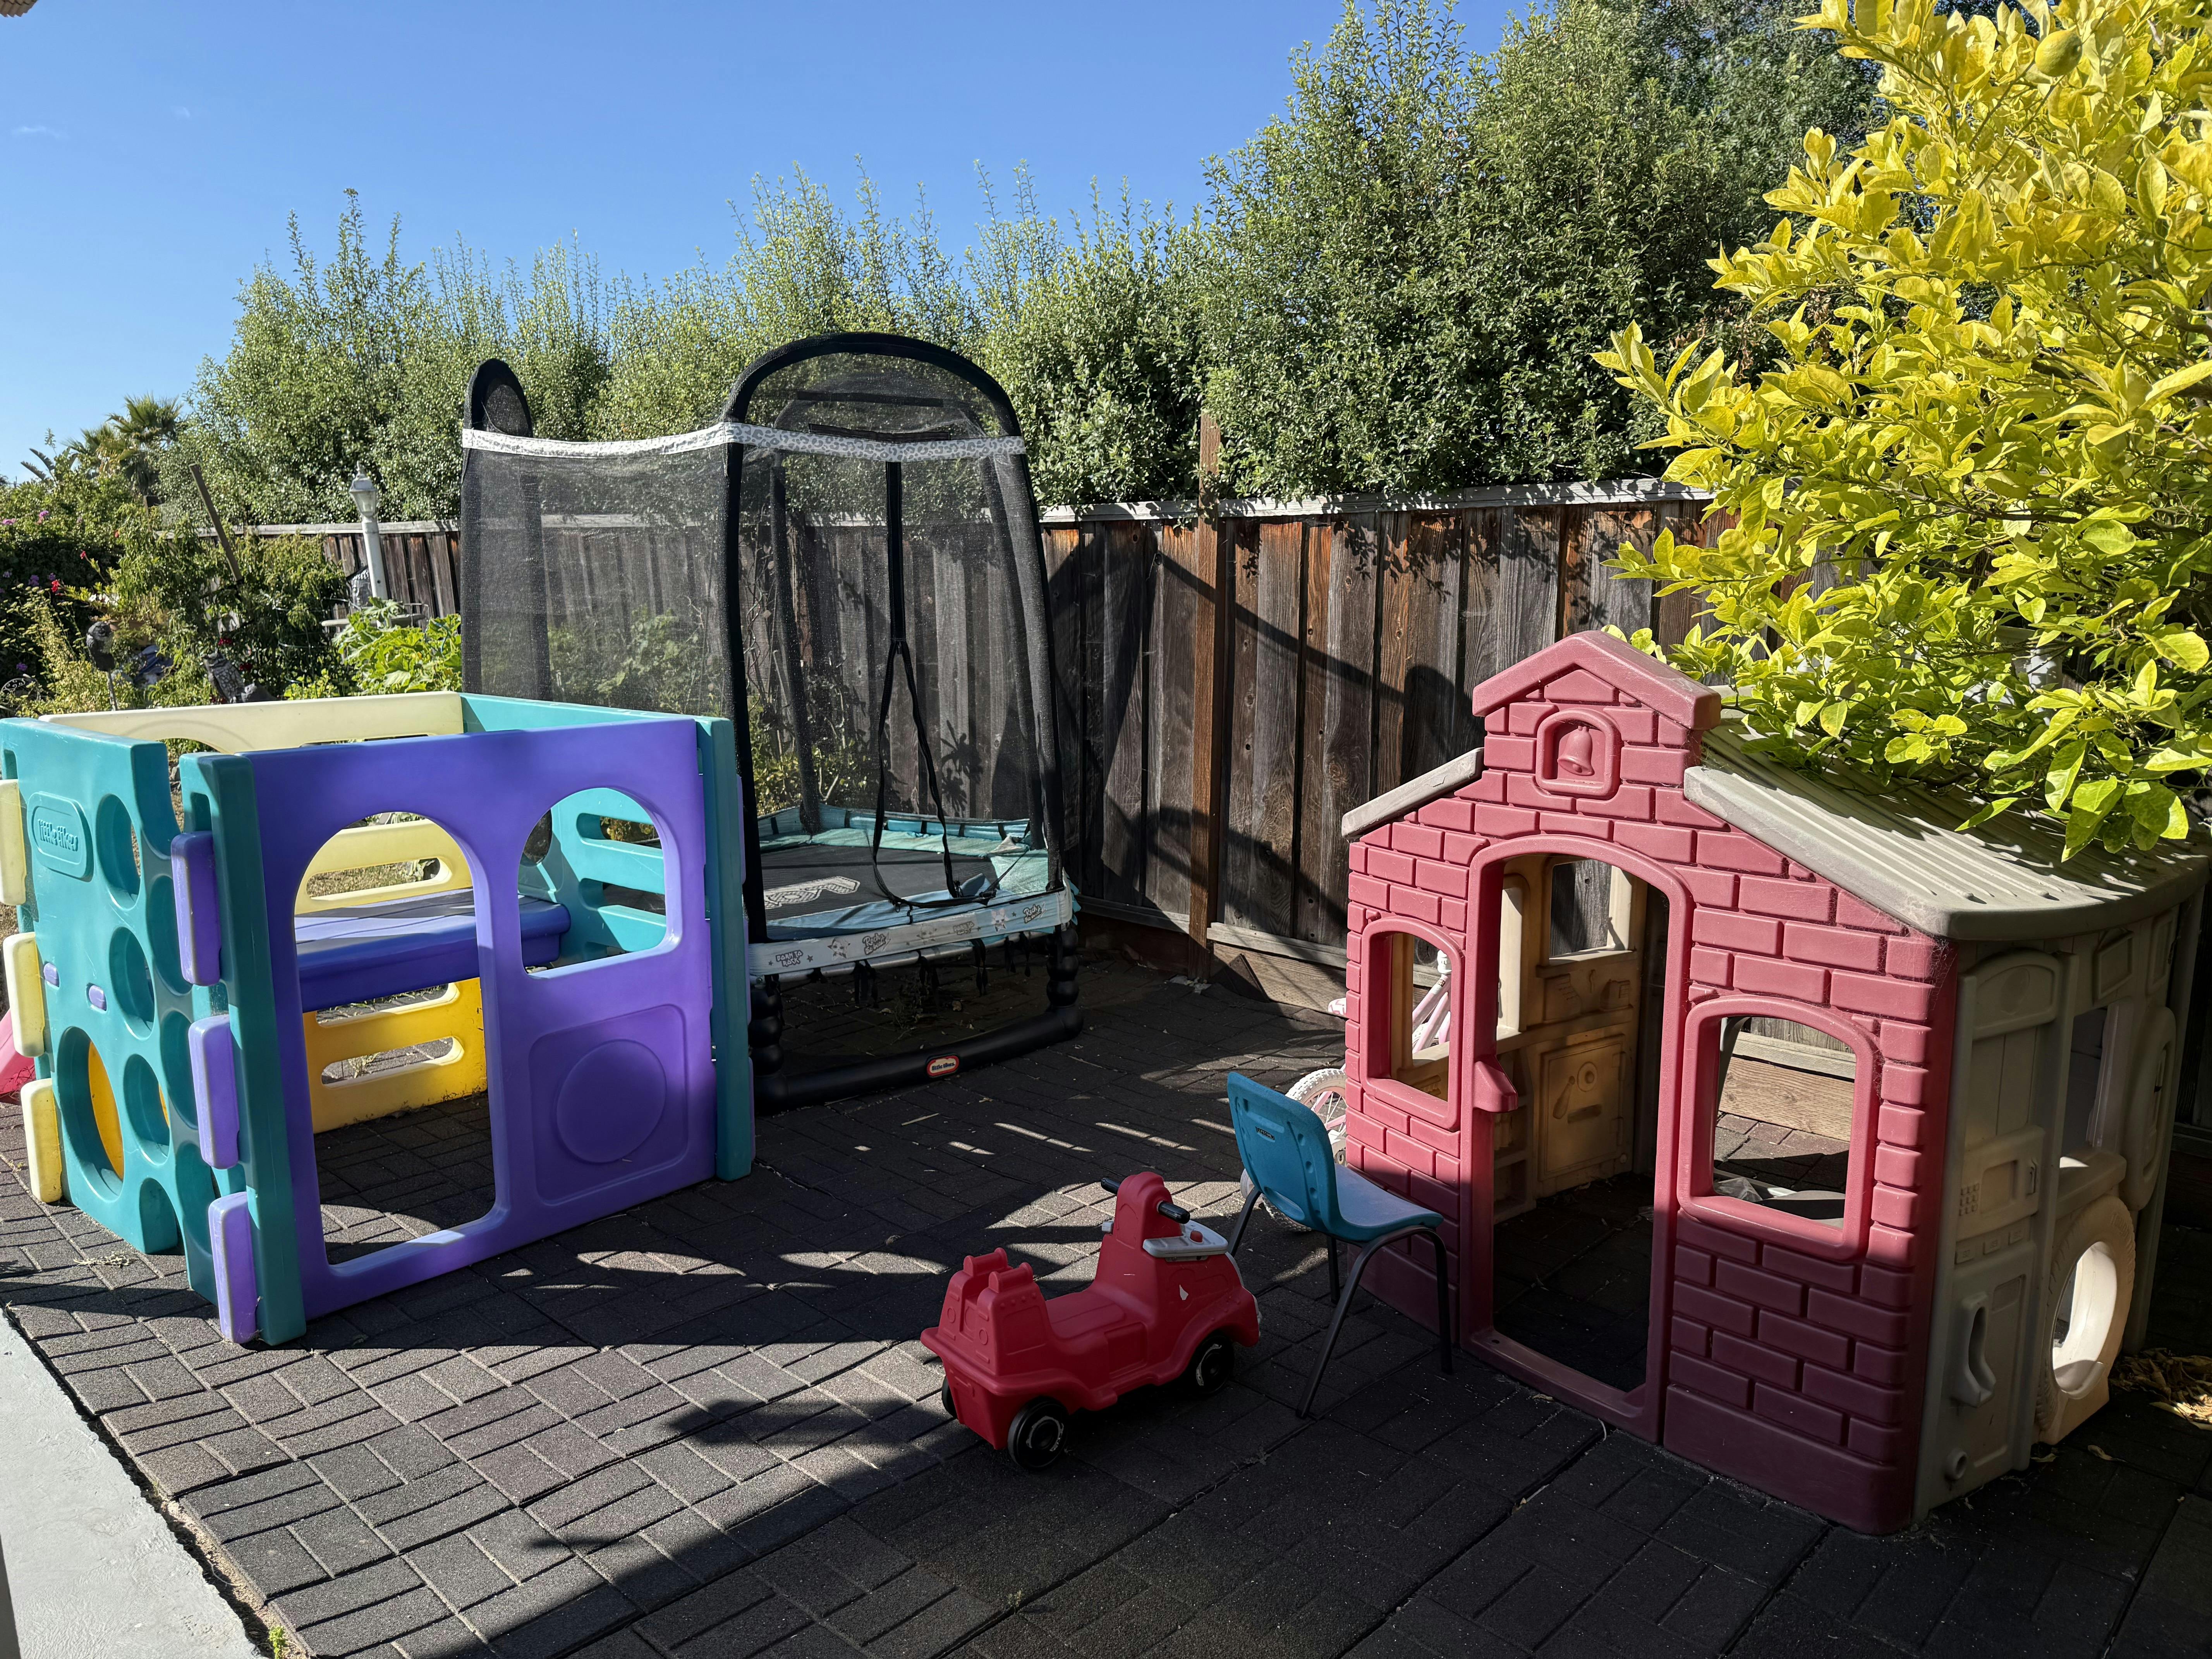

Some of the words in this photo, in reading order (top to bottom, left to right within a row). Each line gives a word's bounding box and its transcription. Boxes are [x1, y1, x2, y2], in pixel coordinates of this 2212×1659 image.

[38, 819, 58, 846] little
[57, 826, 78, 852] tikes
[863, 933, 881, 946] Rock
[776, 952, 793, 961] BORN
[782, 957, 800, 966] ROCK
